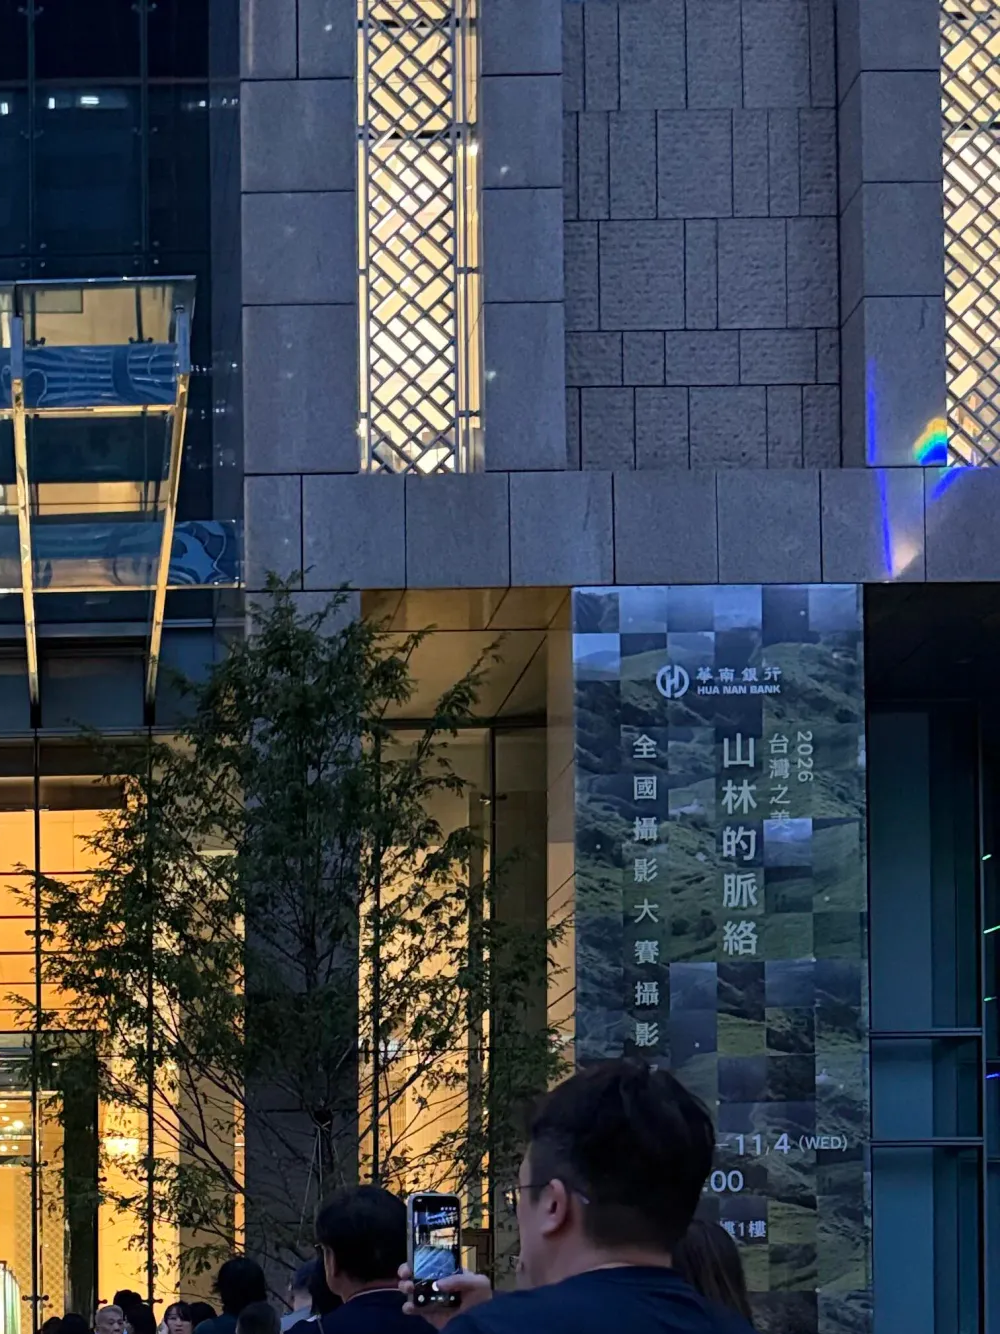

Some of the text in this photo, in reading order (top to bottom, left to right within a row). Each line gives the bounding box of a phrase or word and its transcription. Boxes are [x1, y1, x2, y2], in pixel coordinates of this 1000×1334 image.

[695, 666, 782, 683] 華南銀行
[697, 684, 781, 695] HUA NAN BANK
[769, 732, 791, 831] 台灣之美
[797, 730, 814, 783] 2026
[721, 732, 758, 955] 山林的脈絡
[632, 733, 660, 1072] 全國攝影大賽攝影
[799, 1134, 848, 1153] (WED)
